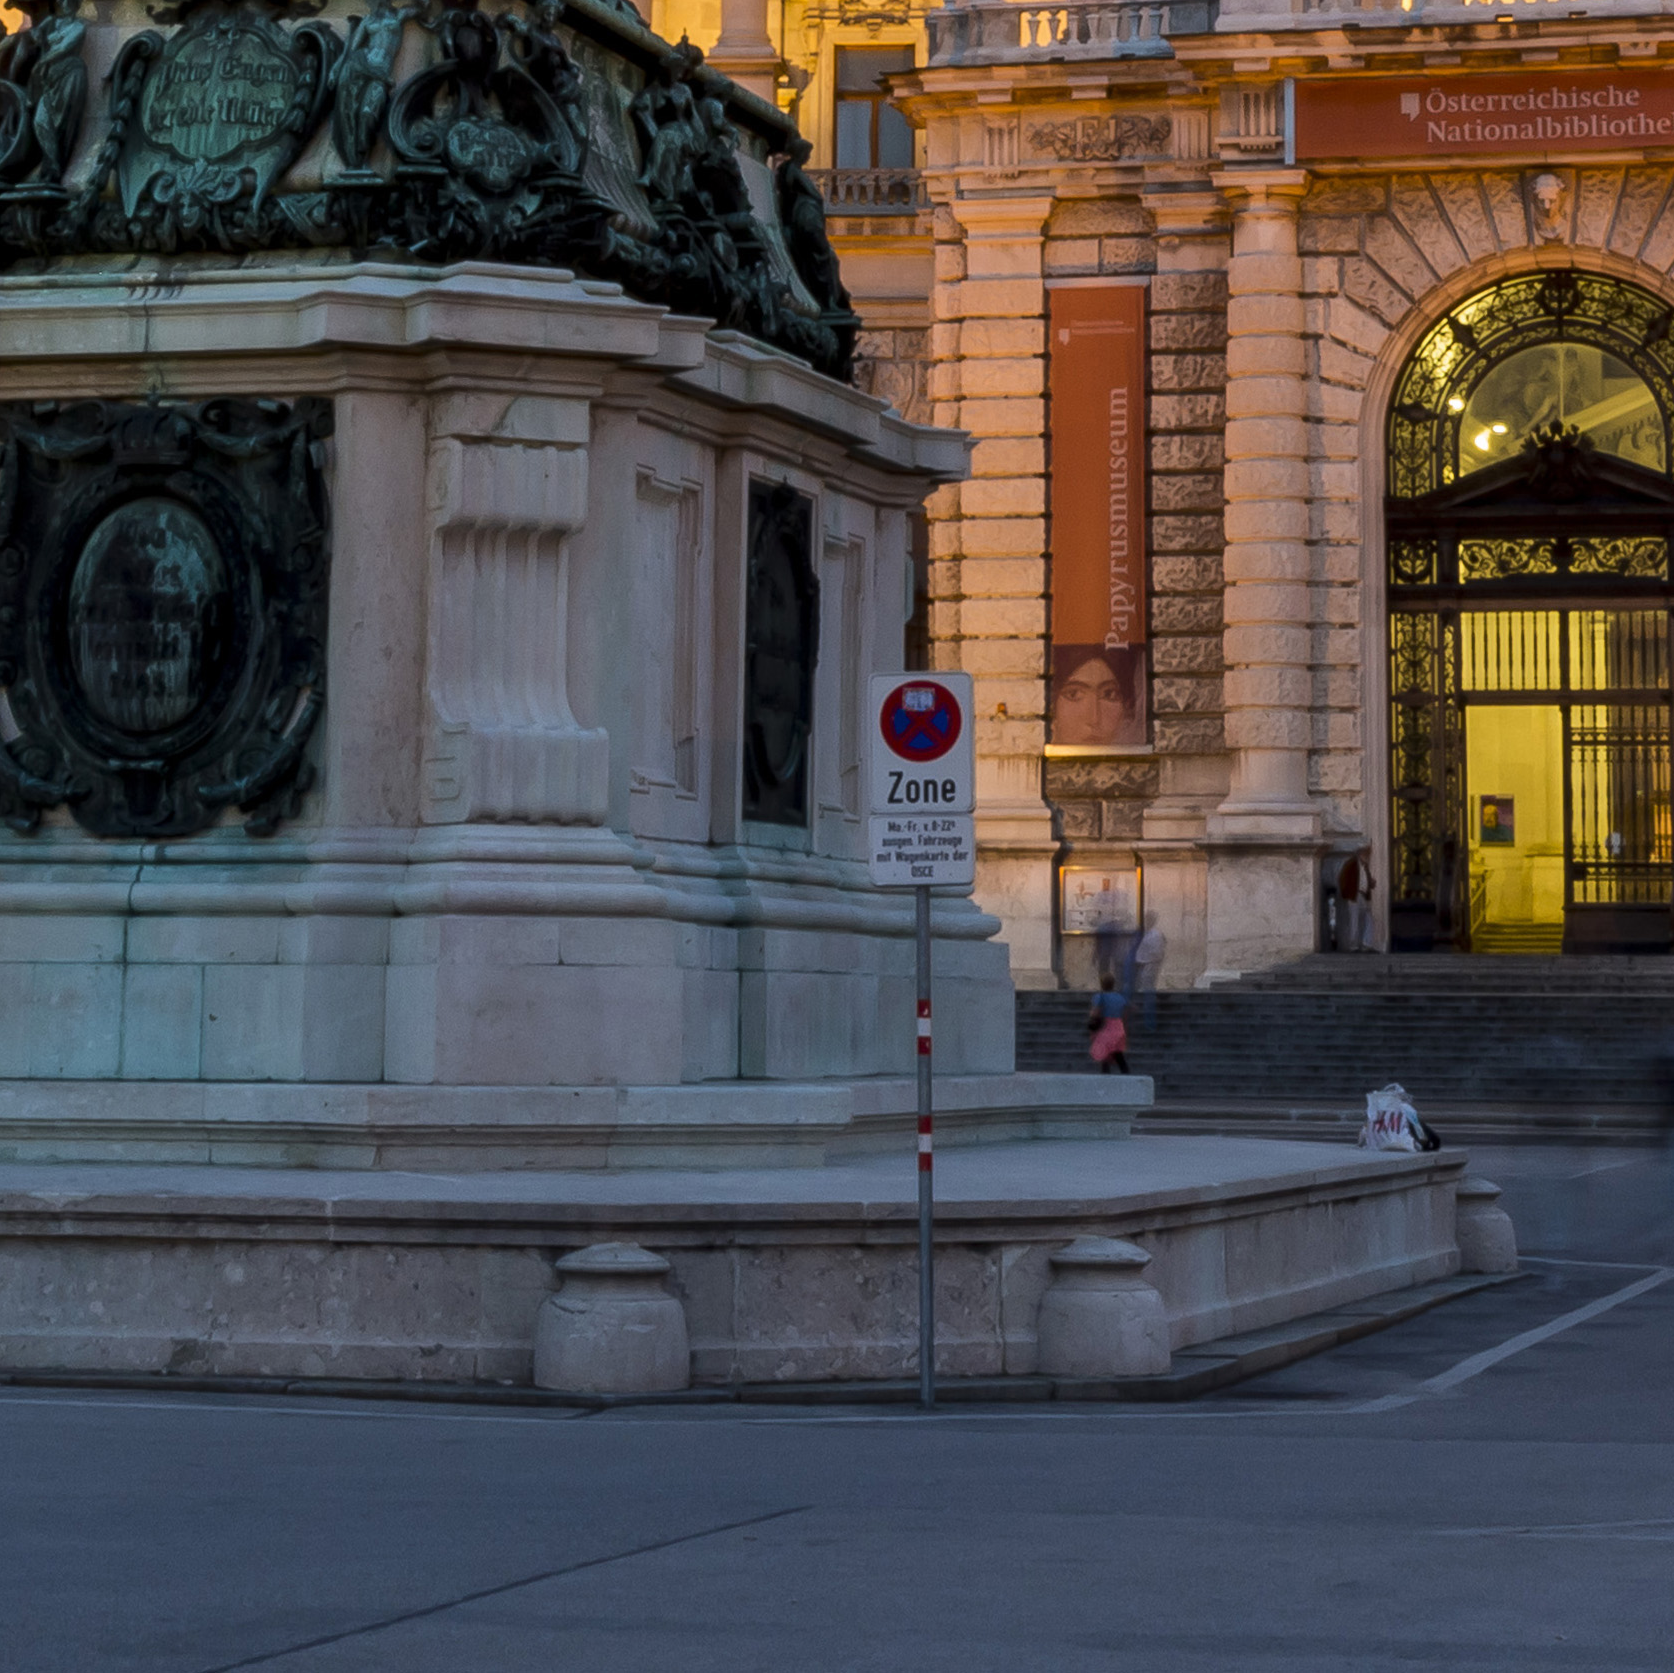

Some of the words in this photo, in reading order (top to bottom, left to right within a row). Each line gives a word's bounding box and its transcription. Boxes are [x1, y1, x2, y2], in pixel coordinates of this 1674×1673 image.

[1426, 85, 1641, 114] Österreichische
[1105, 386, 1137, 652] Papyrusmuseum
[887, 771, 956, 804] Zone
